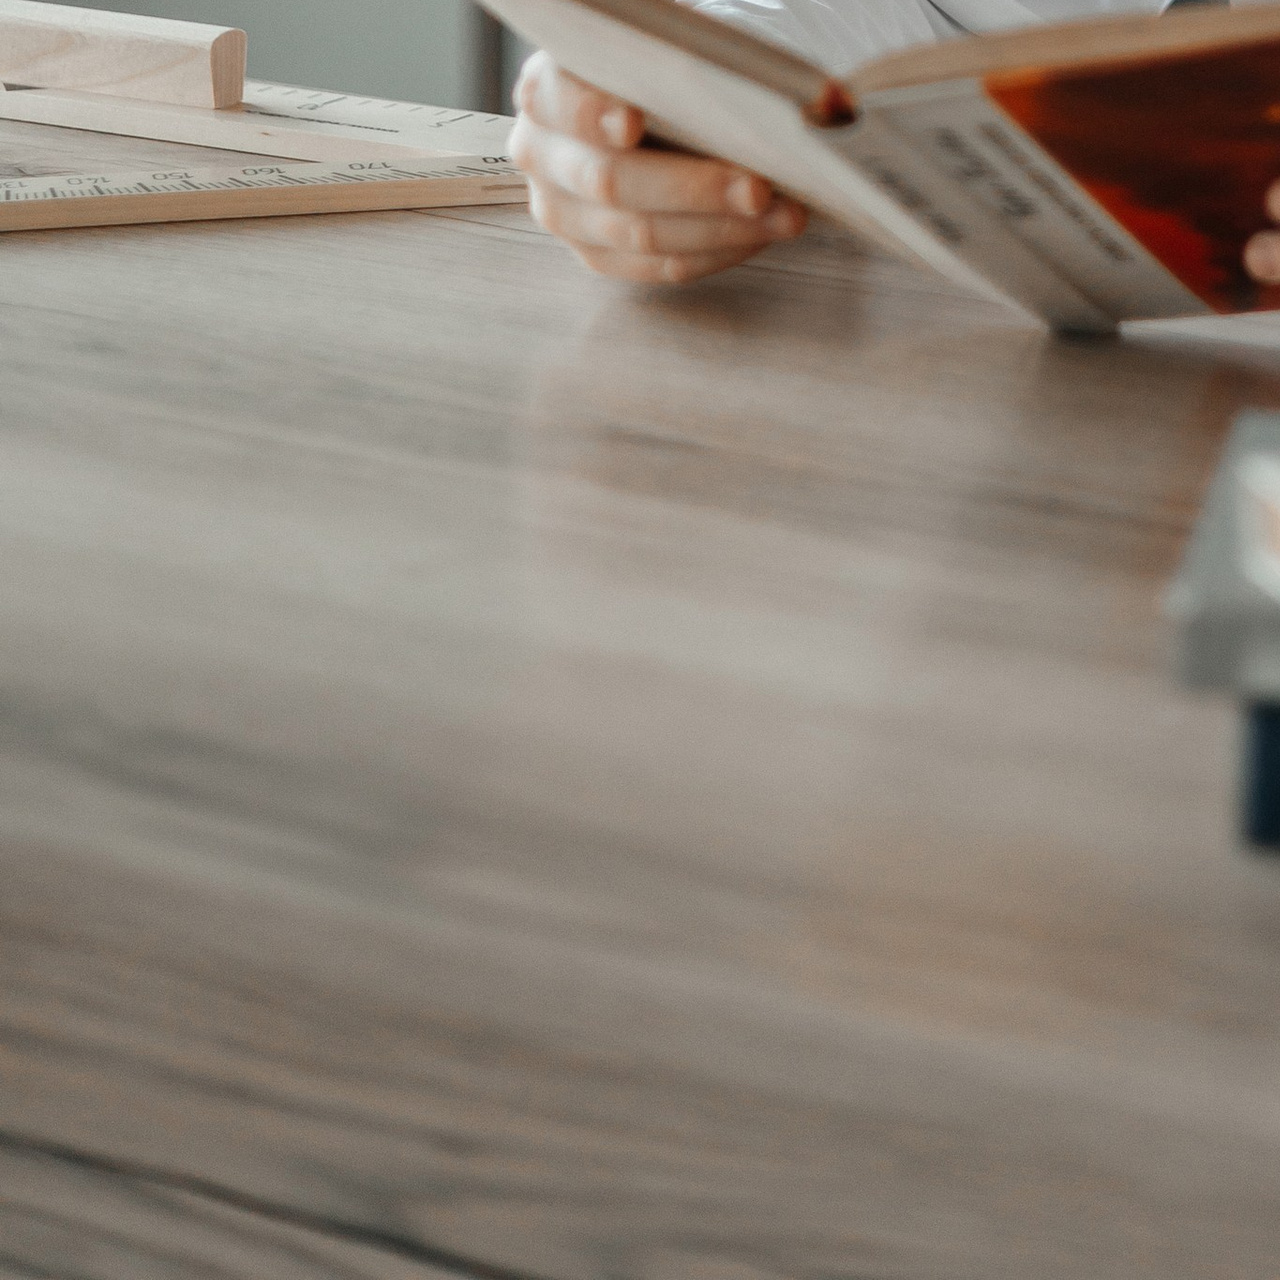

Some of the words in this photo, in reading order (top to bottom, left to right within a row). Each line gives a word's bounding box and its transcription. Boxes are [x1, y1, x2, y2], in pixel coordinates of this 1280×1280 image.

[66, 175, 110, 186] 140
[151, 171, 195, 181] 150
[241, 166, 287, 177] 160
[347, 161, 394, 171] 170
